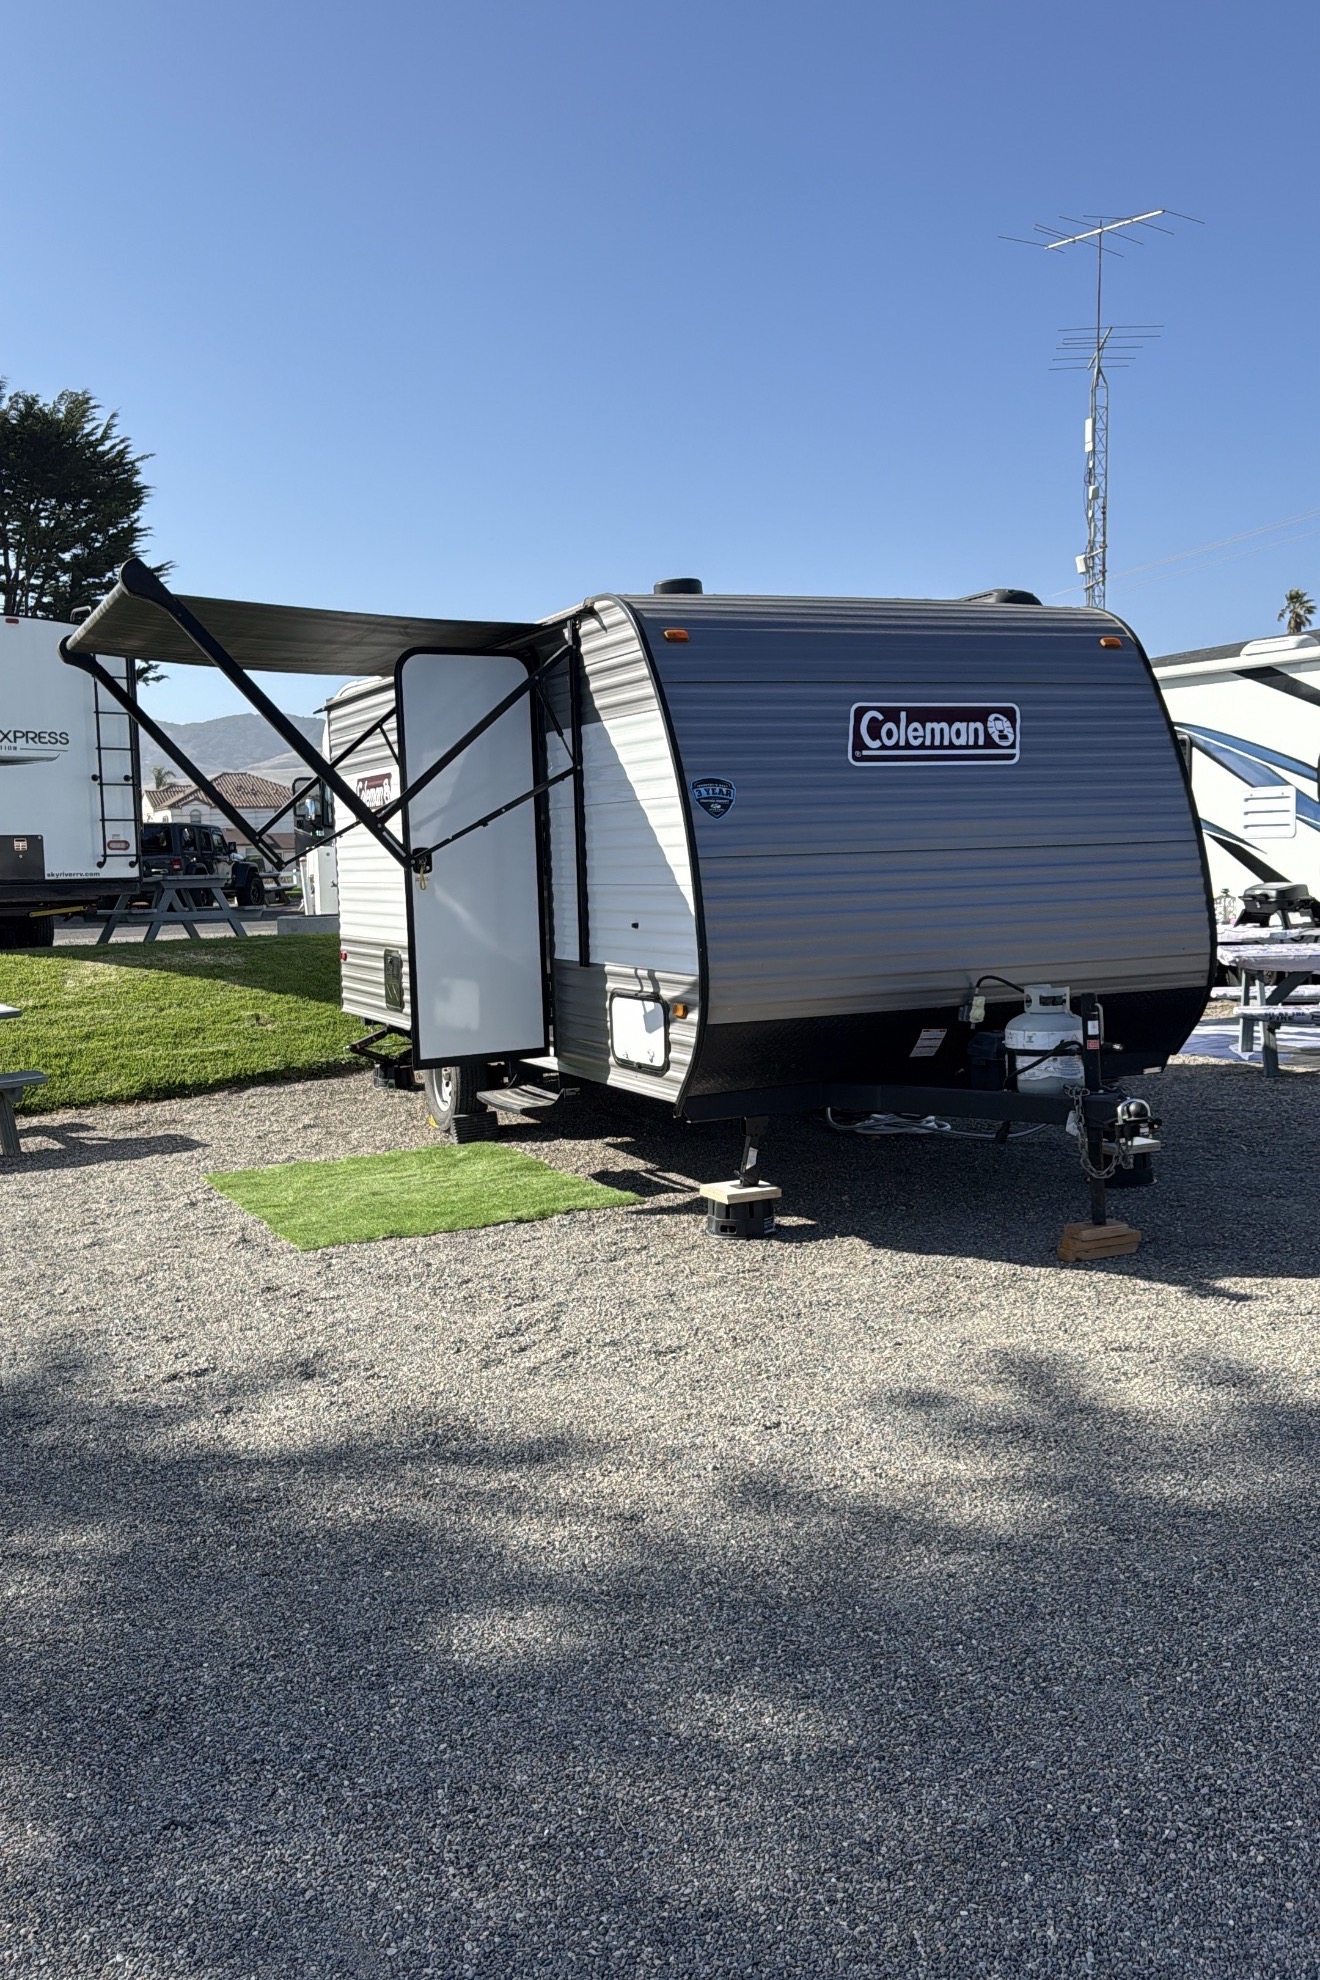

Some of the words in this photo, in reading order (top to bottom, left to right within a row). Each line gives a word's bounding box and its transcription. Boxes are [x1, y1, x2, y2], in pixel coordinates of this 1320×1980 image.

[859, 710, 985, 749] Coleman
[695, 789, 702, 797] 3
[703, 788, 732, 797] YEAR
